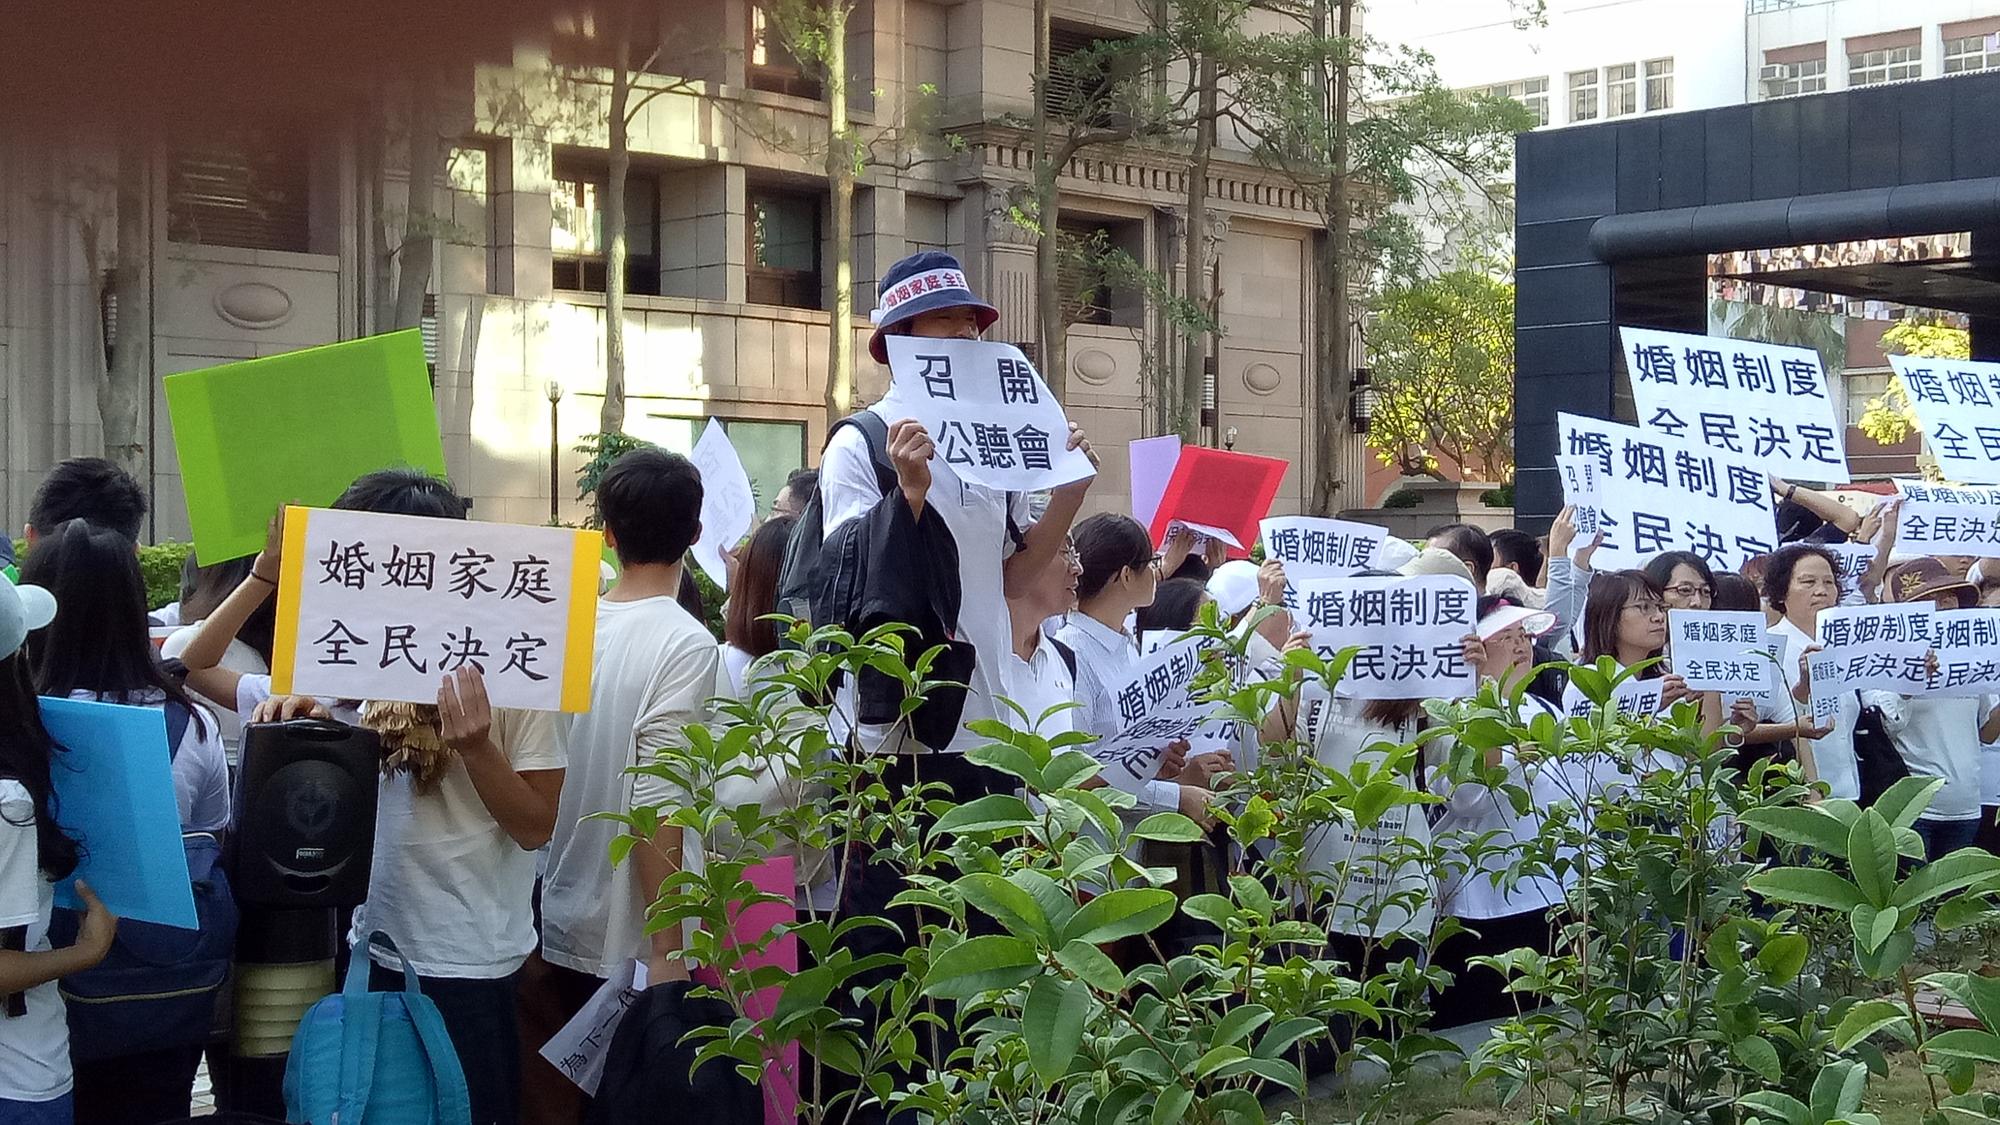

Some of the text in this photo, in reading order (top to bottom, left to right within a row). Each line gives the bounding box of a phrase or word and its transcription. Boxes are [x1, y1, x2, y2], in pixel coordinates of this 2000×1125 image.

[1632, 342, 1825, 399] 婚姻制度
[937, 419, 1053, 471] 公聽會
[1647, 406, 1842, 465] 全民決定
[1567, 427, 1768, 512] 婚姻制度
[1269, 527, 1379, 571] 婚姻制度
[318, 540, 557, 604] 婚姻家庭
[1306, 587, 1470, 628] 婚姻制度
[312, 618, 550, 682] 全民決定
[1682, 620, 1758, 643] 婚姻家庭
[1820, 612, 1932, 649] 婚姻制度
[1686, 660, 1761, 682] 全民決定
[1836, 652, 1926, 684] 民決定
[1924, 659, 2000, 691] 全民決
